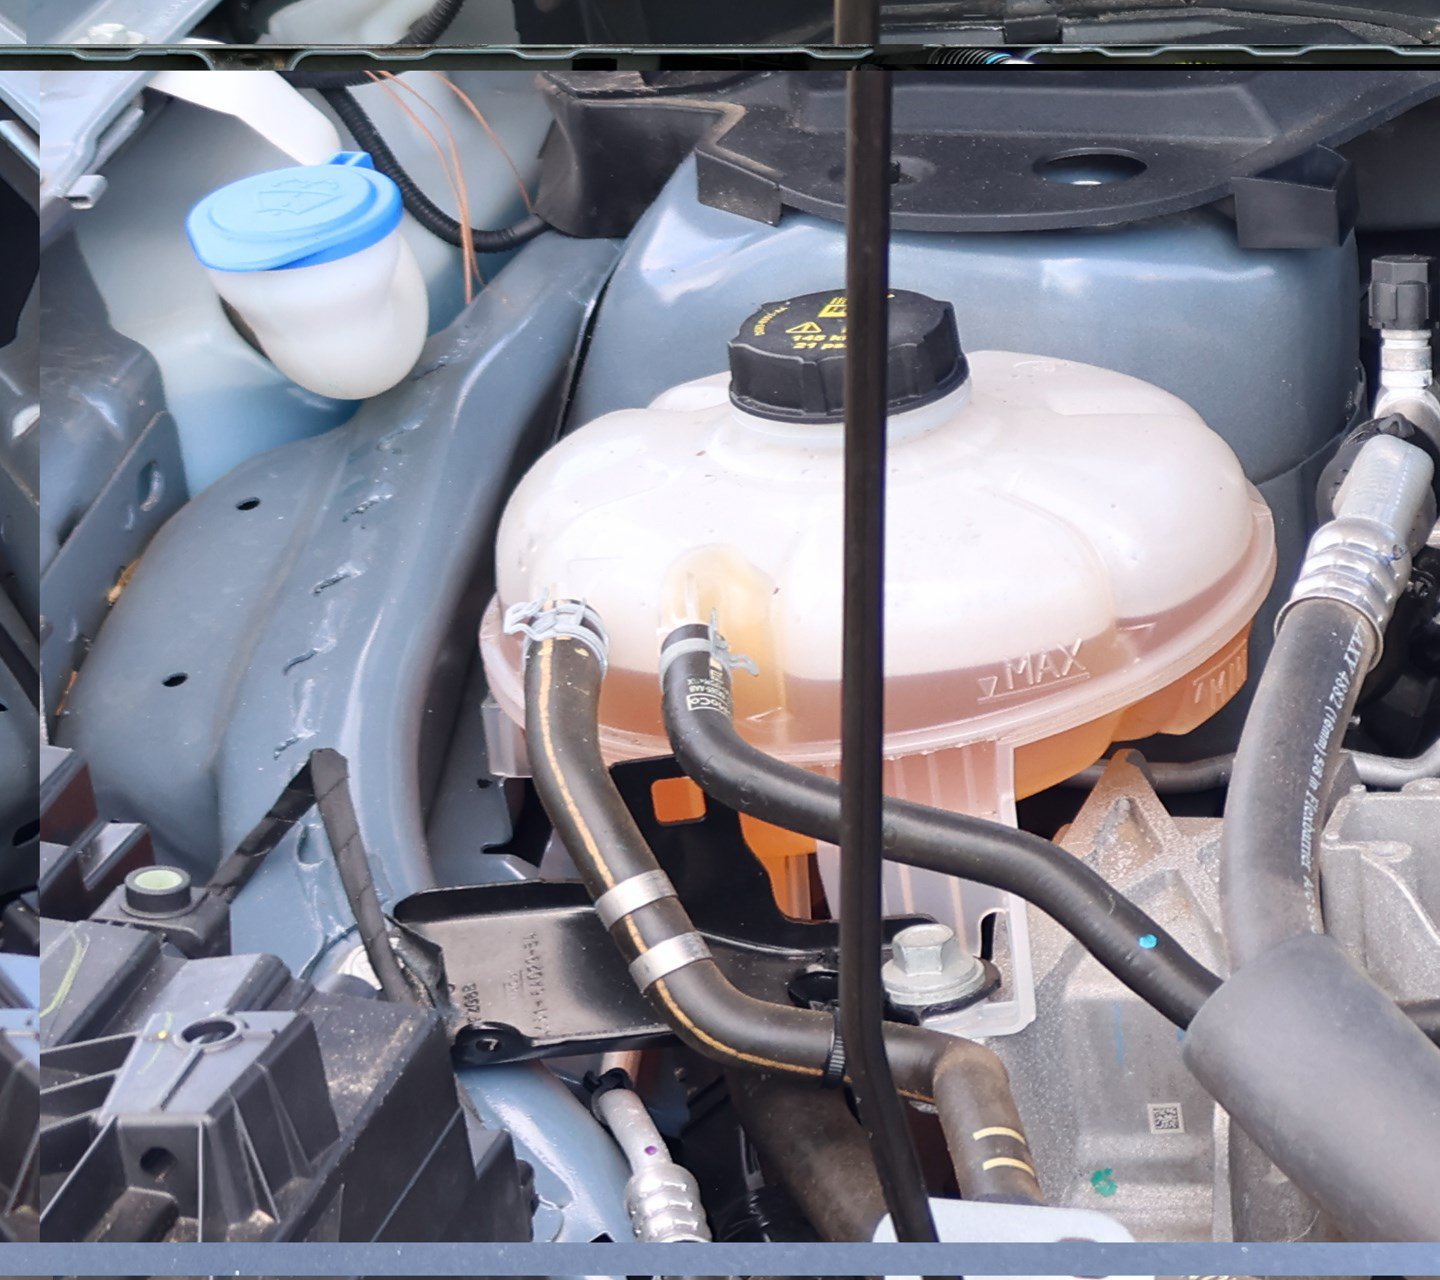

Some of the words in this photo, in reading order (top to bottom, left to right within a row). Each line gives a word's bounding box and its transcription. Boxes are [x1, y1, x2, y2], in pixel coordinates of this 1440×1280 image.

[1004, 637, 1088, 691] MAX
[1329, 669, 1350, 711] 4882
[1300, 789, 1320, 872] Flexbarrier
